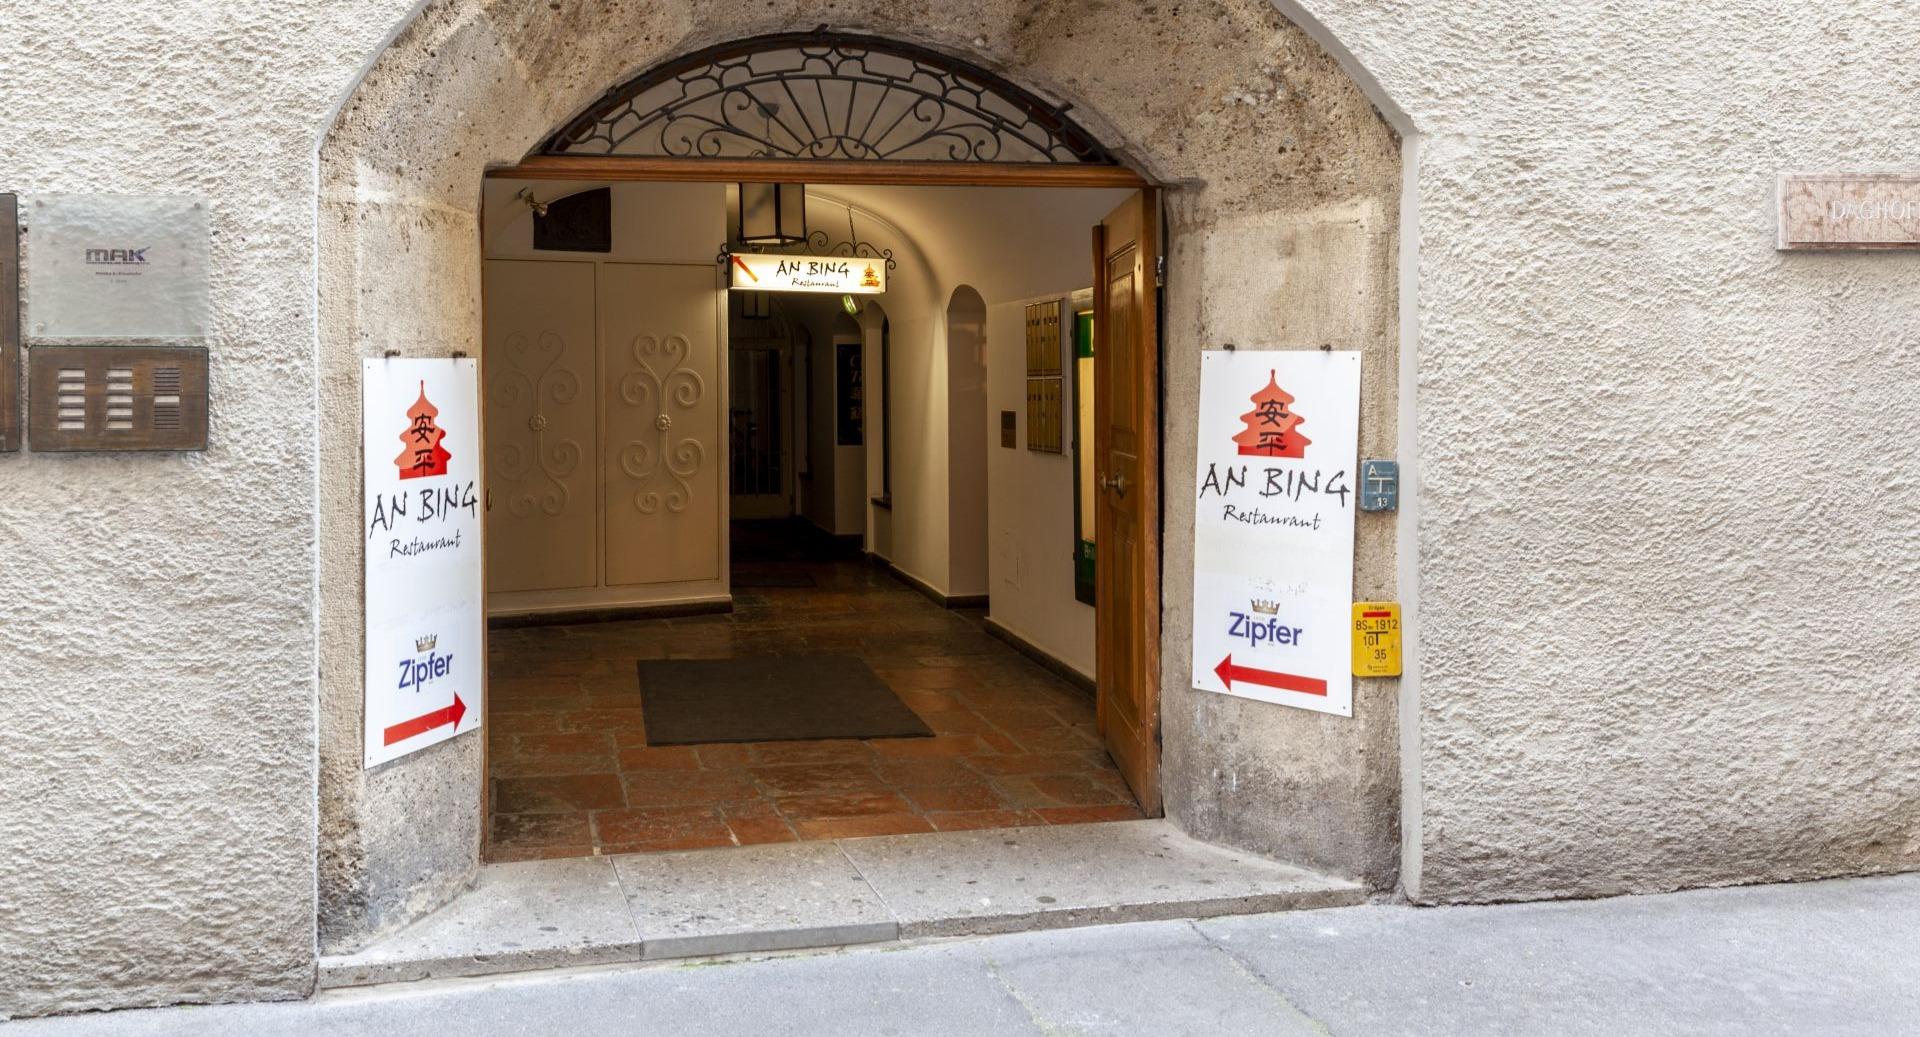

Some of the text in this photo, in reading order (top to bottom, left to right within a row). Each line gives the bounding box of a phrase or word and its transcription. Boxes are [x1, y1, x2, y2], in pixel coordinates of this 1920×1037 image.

[1832, 200, 1920, 220] DAGHOF
[776, 260, 800, 277] AN
[807, 262, 850, 279] BING
[792, 278, 839, 288] Restaurant
[1256, 399, 1289, 457] 安平
[411, 413, 435, 477] 安平
[1368, 464, 1377, 476] A
[1200, 463, 1351, 507] AN BING
[369, 481, 478, 539] AN BING
[1223, 504, 1321, 531] Restaurant
[390, 529, 462, 559] Restaurant
[1228, 611, 1303, 648] Zipfer
[1355, 619, 1398, 631] BS 1912
[1363, 635, 1374, 646] 10
[1374, 649, 1387, 660] 35
[398, 652, 453, 693] Zipfer
